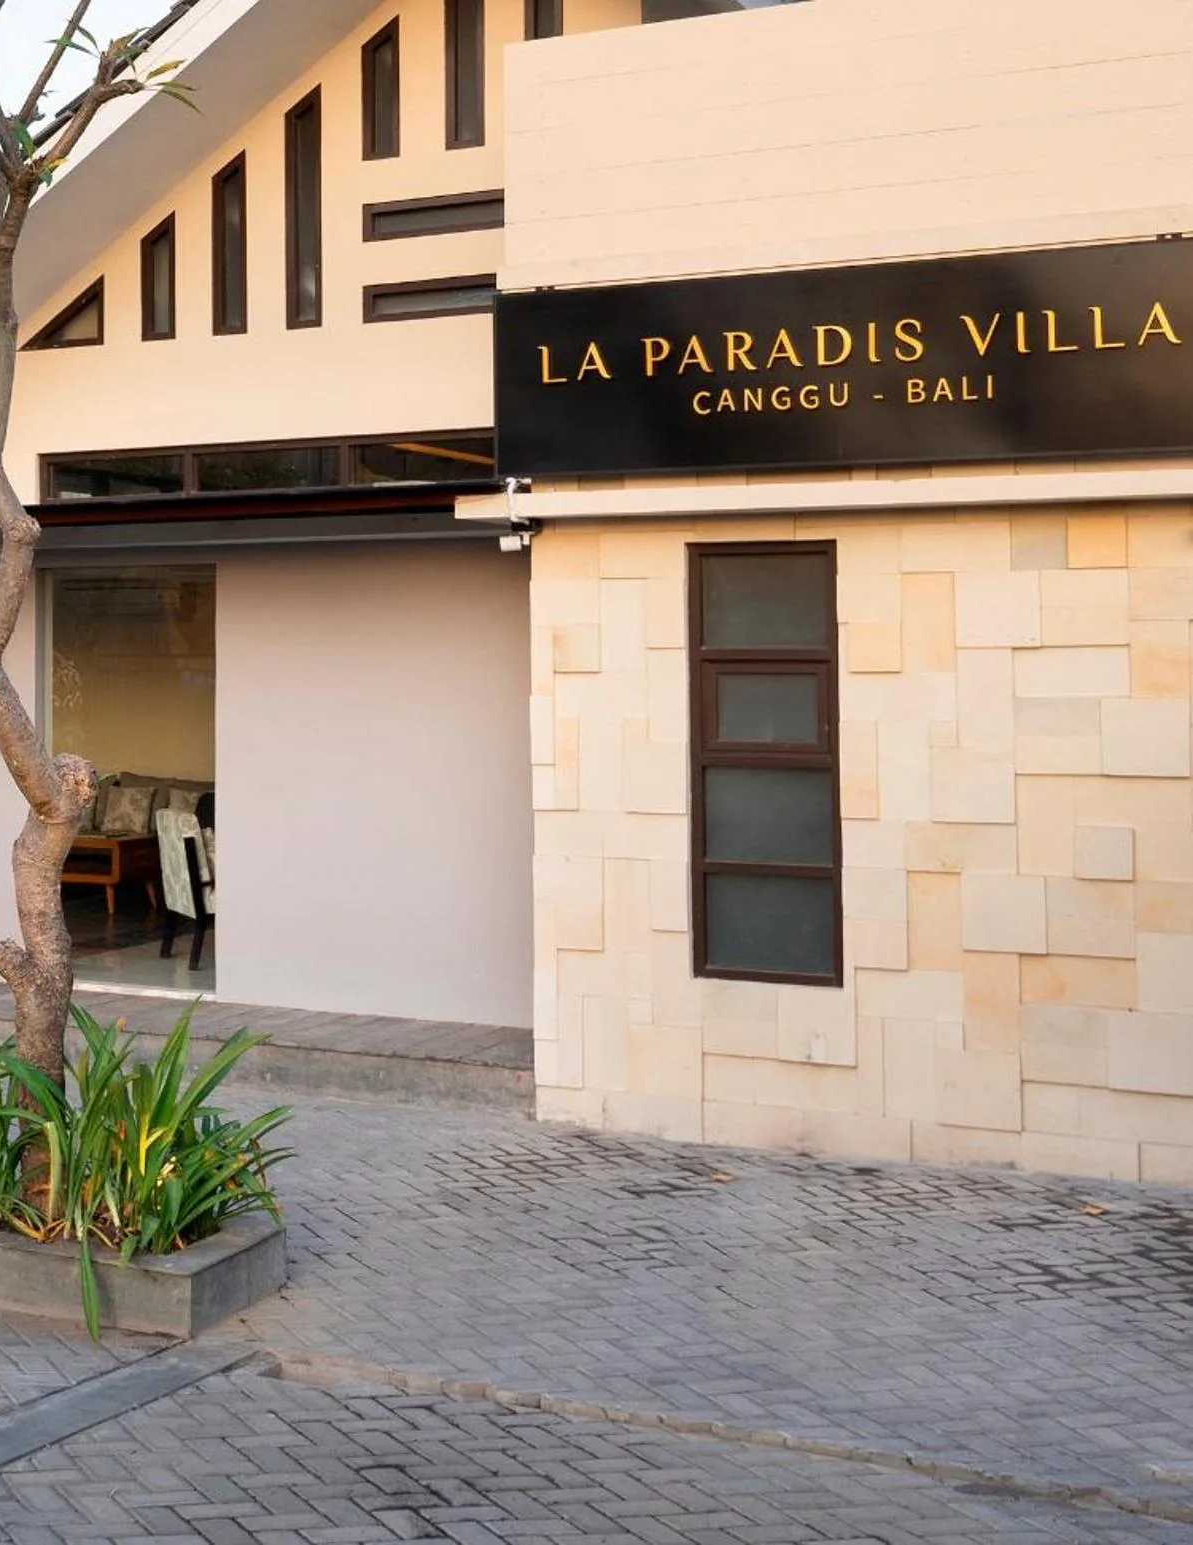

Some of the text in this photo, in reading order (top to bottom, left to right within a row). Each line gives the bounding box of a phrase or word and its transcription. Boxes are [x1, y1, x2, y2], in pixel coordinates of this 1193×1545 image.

[537, 301, 1183, 384] LA PARADIS VILLA
[691, 381, 850, 415] CANGGU
[906, 374, 994, 404] BALI
